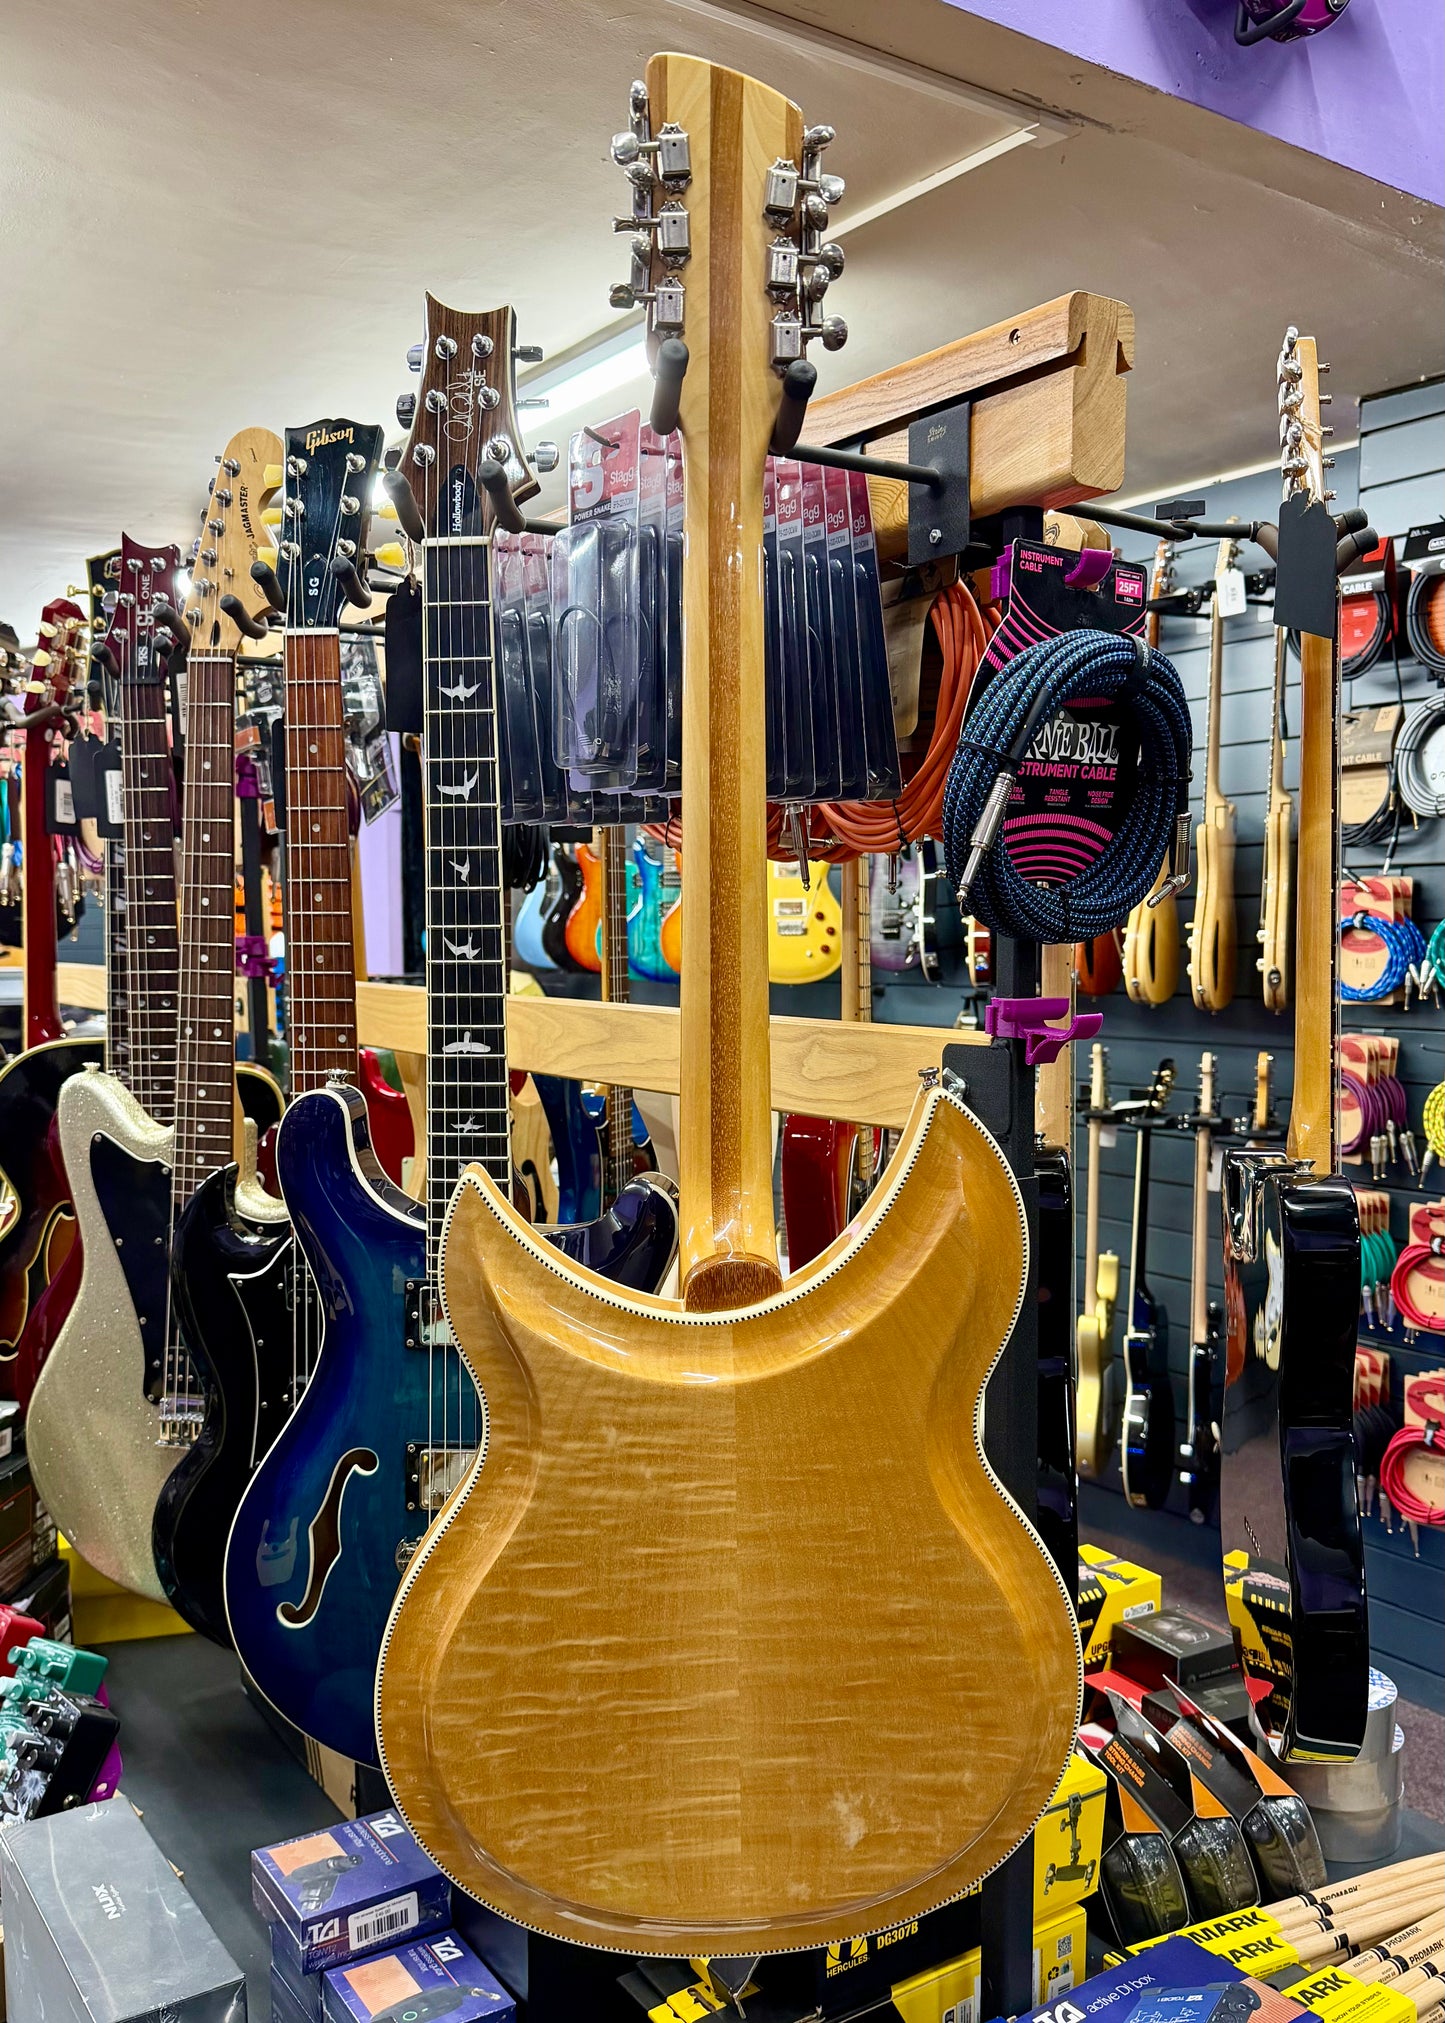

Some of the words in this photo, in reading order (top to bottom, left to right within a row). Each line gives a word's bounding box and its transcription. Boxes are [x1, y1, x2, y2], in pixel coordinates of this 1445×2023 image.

[474, 369, 487, 387] SE
[306, 427, 354, 456] Gibson
[239, 485, 255, 540] JAGMASTER
[452, 480, 465, 533] Hollowbody
[573, 508, 593, 522] POWER
[593, 502, 611, 517] SNAKE
[1020, 550, 1064, 567] INSTRUMENT
[1020, 560, 1043, 573] CABLE
[141, 574, 150, 600] ONE
[308, 577, 320, 596] SG
[1118, 581, 1140, 595] 25FT
[1342, 581, 1373, 595] CABLE
[138, 645, 149, 666] PRS
[1071, 721, 1120, 764] BALL
[1356, 752, 1382, 763] CABLE
[1017, 761, 1079, 779] STRUMENT
[1081, 766, 1118, 781] CABLE
[1044, 795, 1071, 803] RESISTANT
[1169, 1734, 1183, 1750] TOOL
[1181, 1748, 1192, 1757] KIT
[1173, 1729, 1190, 1749] STRING
[1190, 1747, 1212, 1770] CHANGE
[1104, 1750, 1118, 1766] TOOL
[1116, 1765, 1126, 1775] KIT
[1108, 1744, 1126, 1765] STRING
[1124, 1763, 1145, 1788] CHANGE
[1112, 1741, 1130, 1760] GUITAR
[1132, 1761, 1145, 1779] BASS
[369, 1813, 406, 1839] TGI
[308, 1917, 340, 1945] TGI
[877, 1921, 919, 1950] DG307B
[1385, 1925, 1423, 1948] PROMARK
[431, 1936, 464, 1963] TGI
[1408, 1940, 1445, 1965] PROMARK
[826, 1953, 868, 1978] HERCULES
[1086, 1990, 1120, 2013] active
[1115, 1983, 1131, 1996] DI
[1130, 1973, 1156, 1989] box
